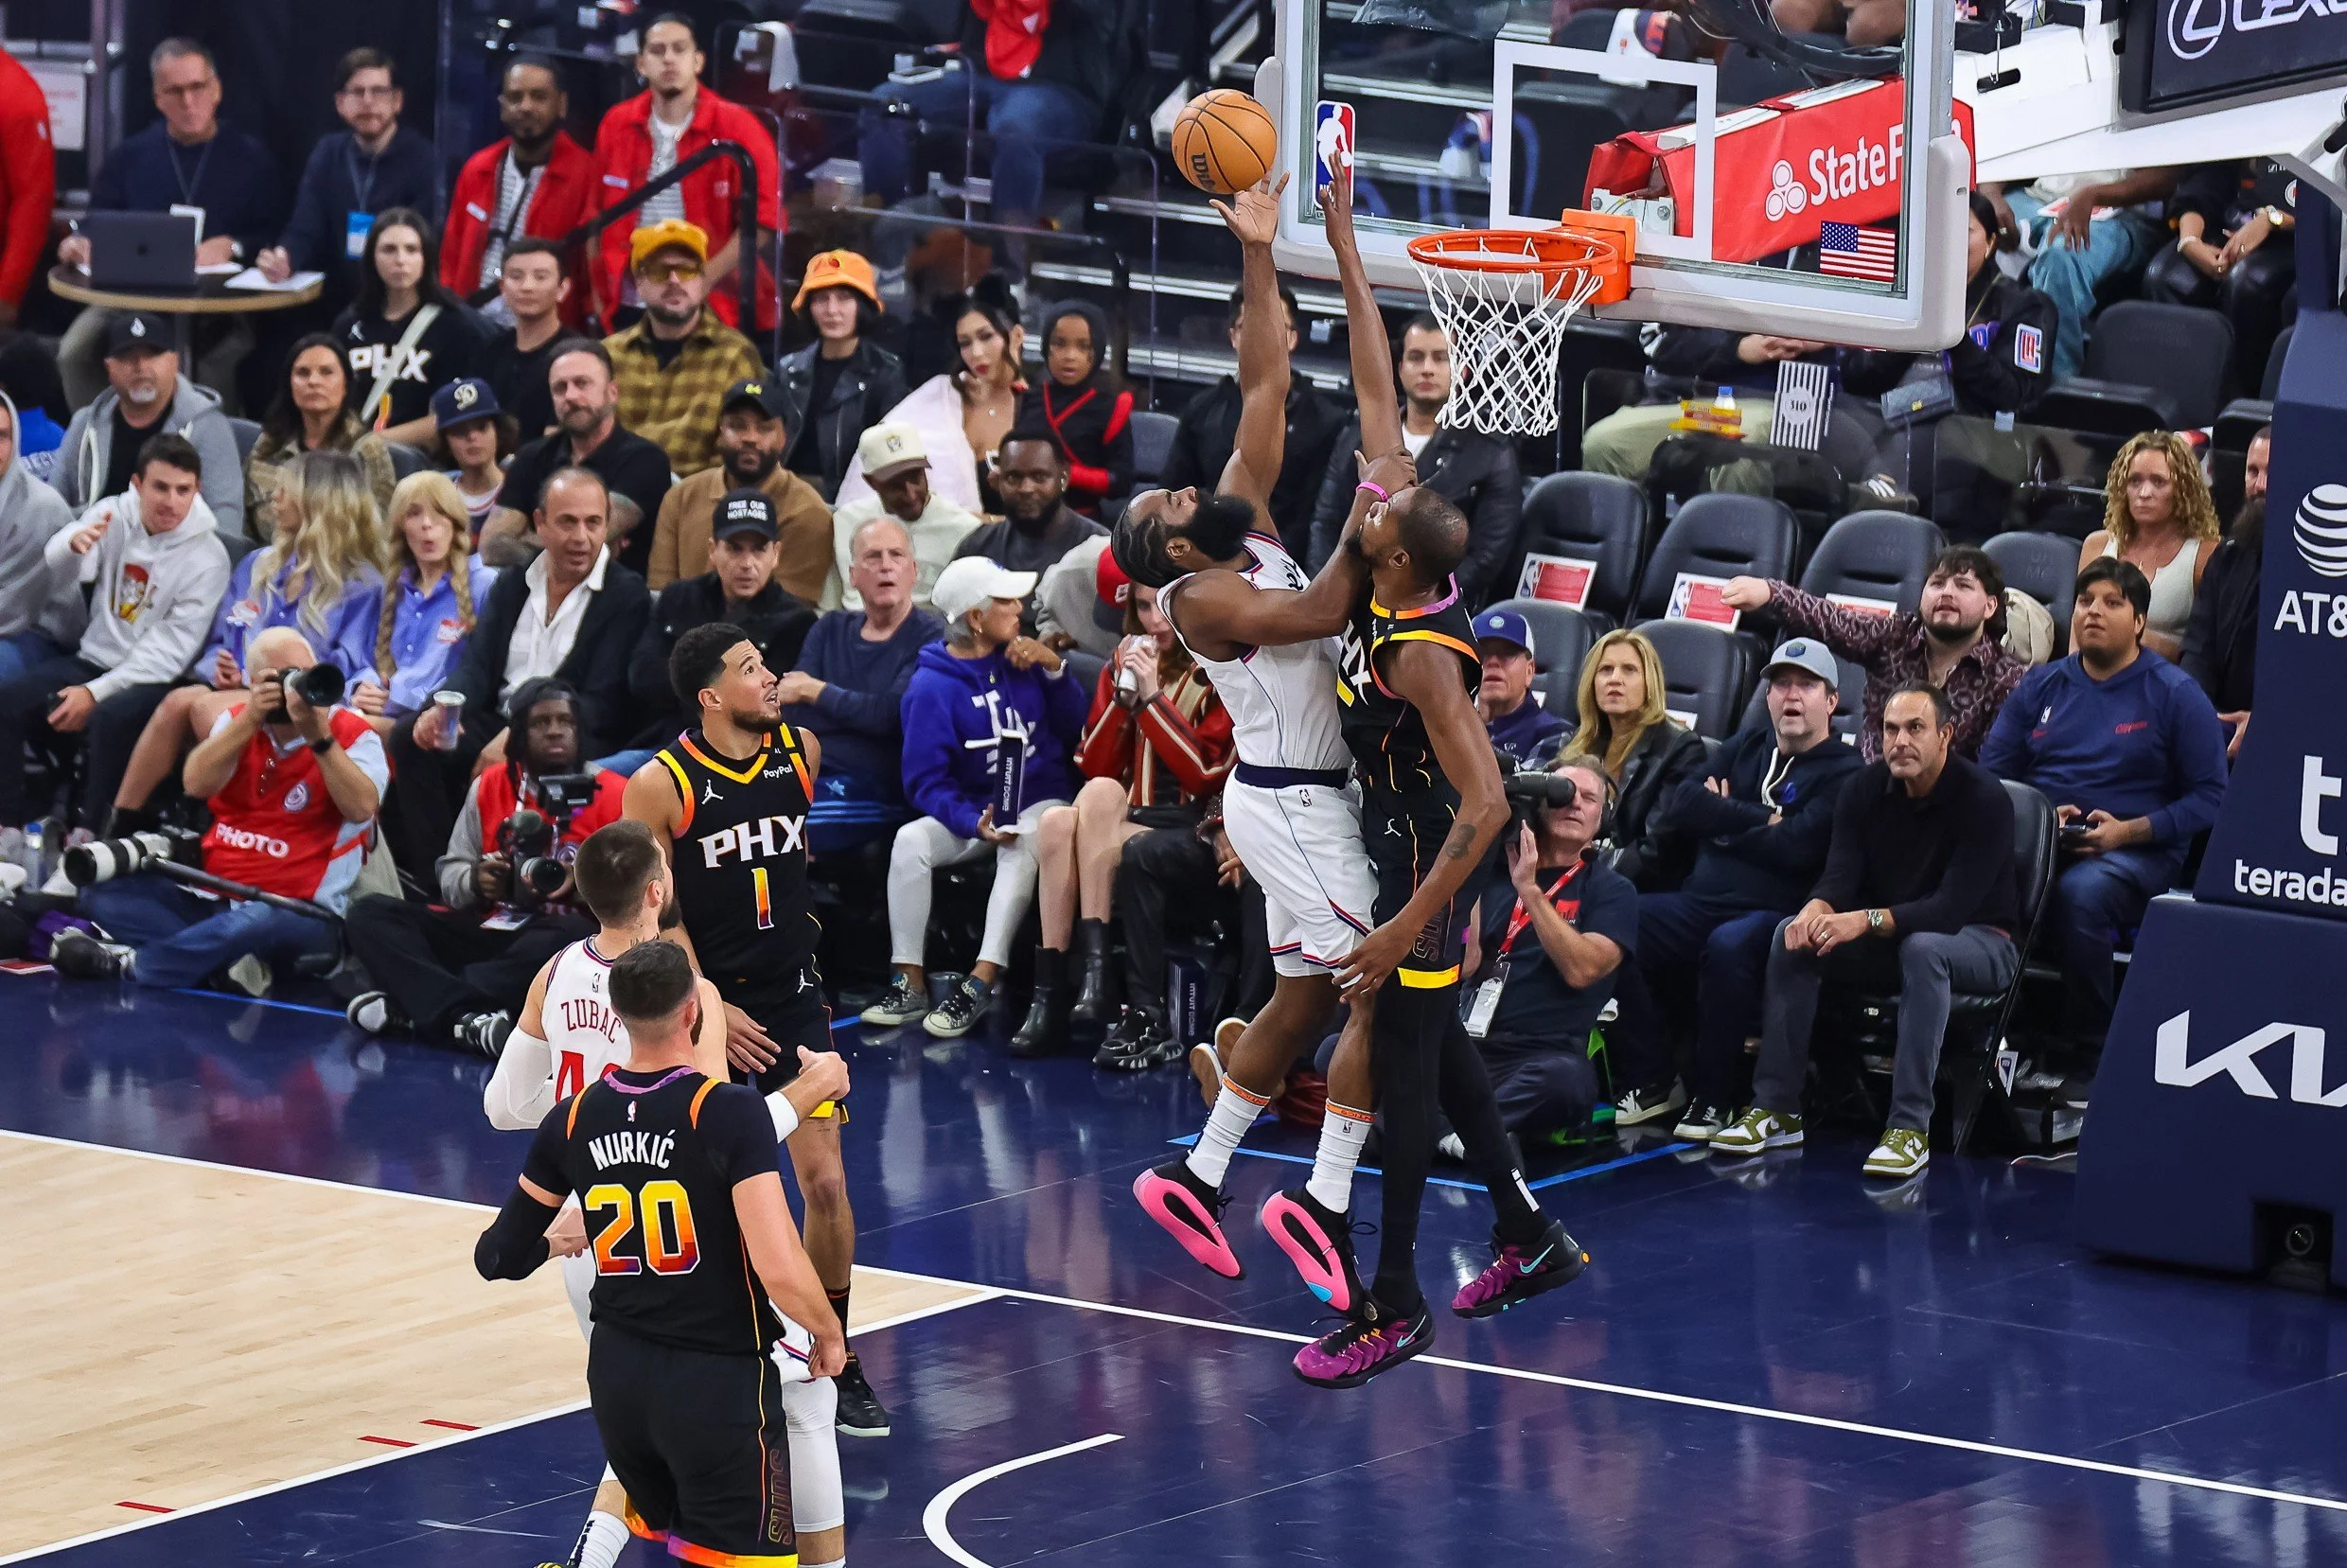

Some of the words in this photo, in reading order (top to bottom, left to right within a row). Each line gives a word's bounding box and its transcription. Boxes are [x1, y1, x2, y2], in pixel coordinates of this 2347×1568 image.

[763, 764, 793, 778] PayPal
[215, 822, 290, 858] PHOTO
[697, 815, 805, 869] PHX
[751, 868, 775, 930] 1
[560, 999, 621, 1044] ZUBAC
[588, 1129, 676, 1171] NURKIĆ
[585, 1180, 700, 1276] 20
